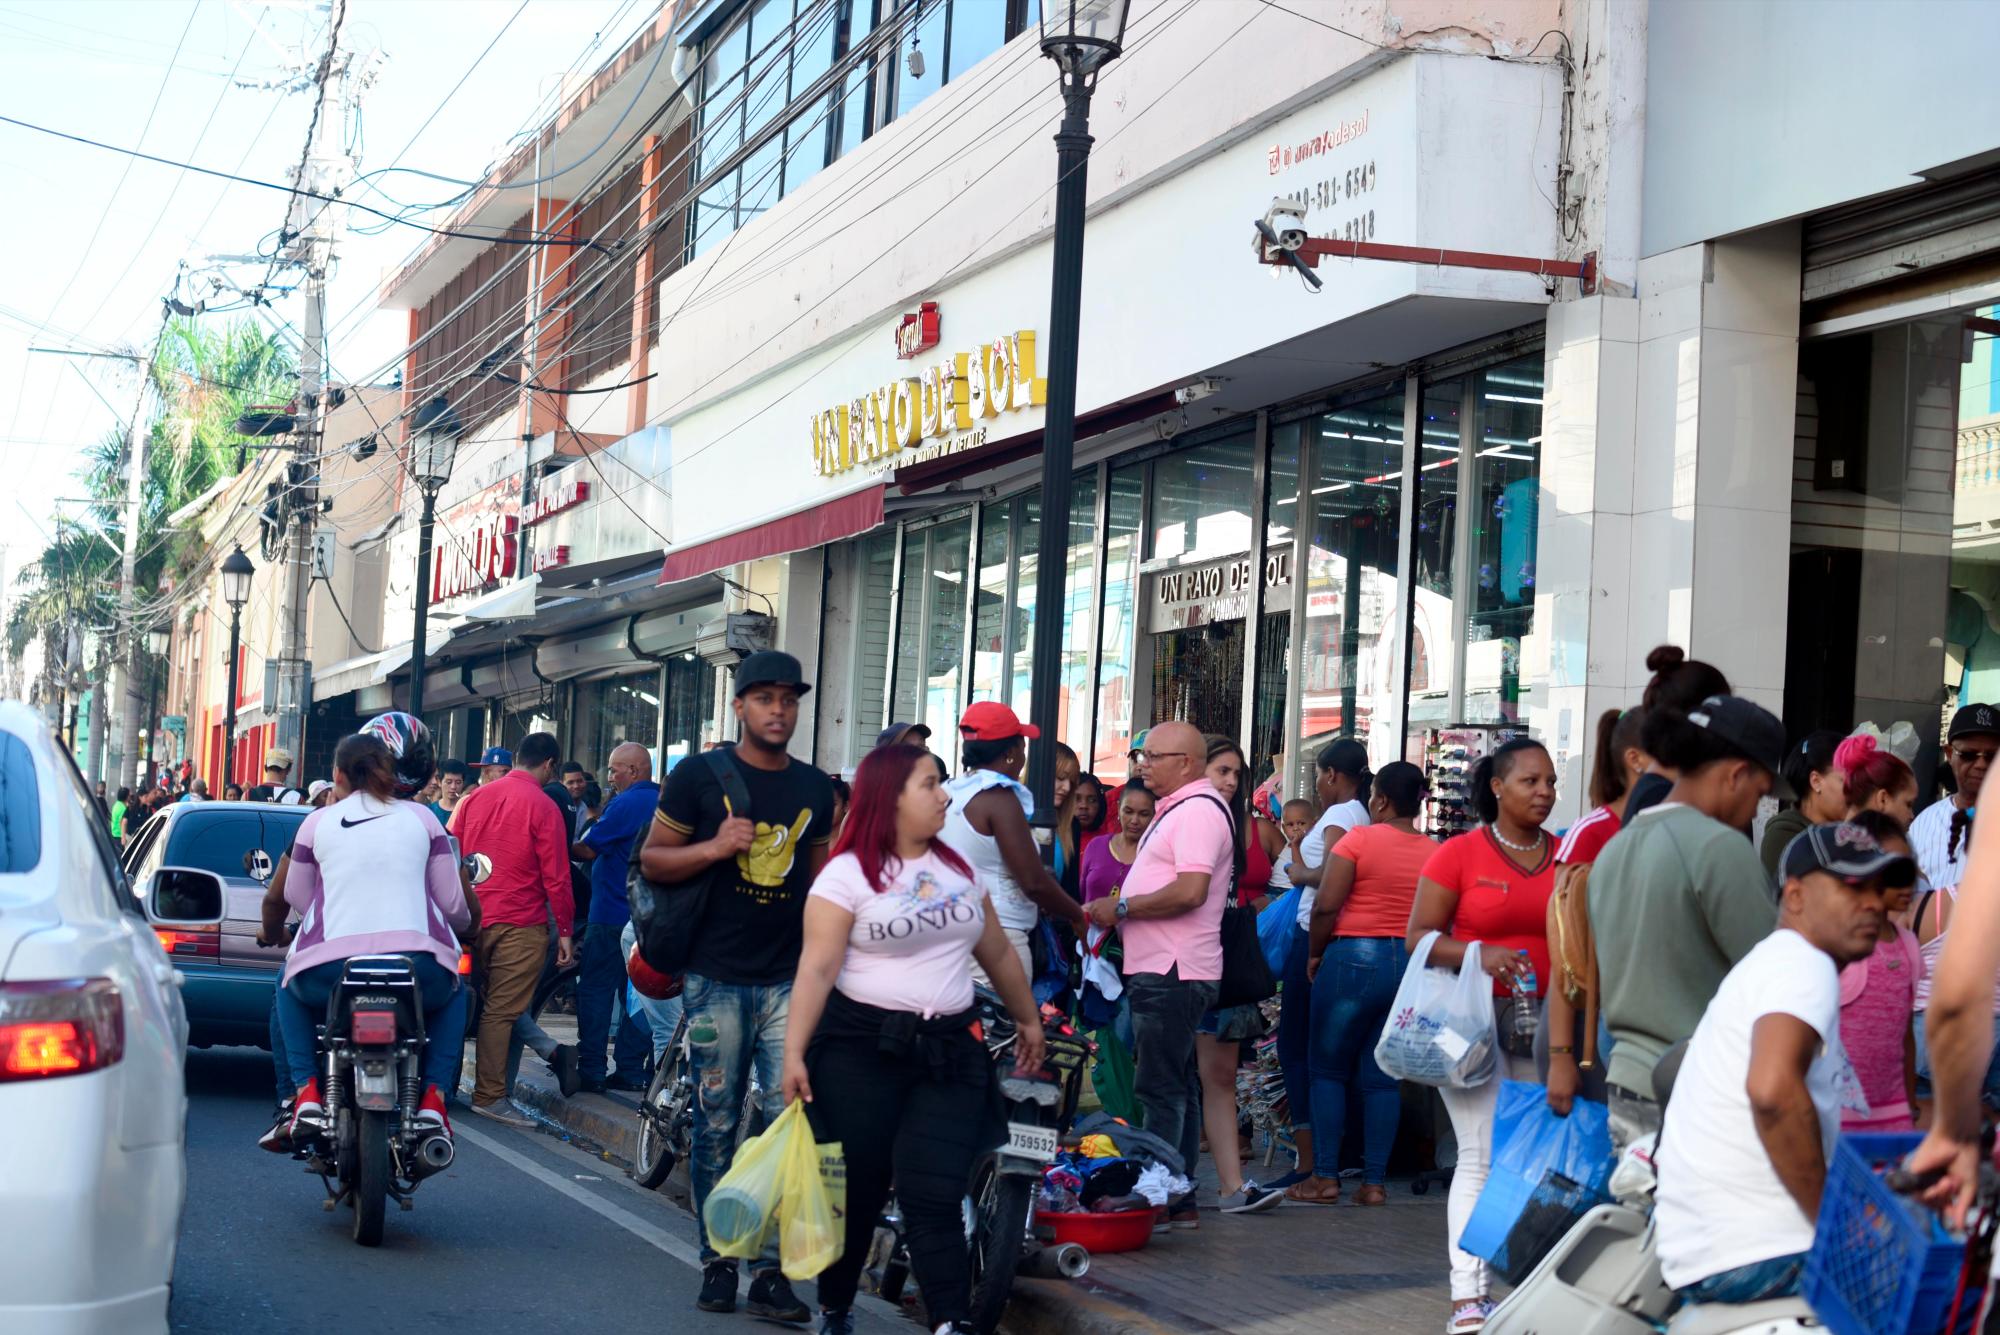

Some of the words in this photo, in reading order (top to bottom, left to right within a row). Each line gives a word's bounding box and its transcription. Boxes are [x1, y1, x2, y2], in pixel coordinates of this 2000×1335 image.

[810, 405, 847, 477] UN
[849, 376, 917, 467] RAYO
[920, 352, 966, 438] DE
[967, 330, 1043, 420] SOL
[1159, 573, 1181, 603] UN
[1187, 567, 1223, 600] RAYO
[1229, 560, 1250, 593] DE
[1265, 553, 1290, 588] OL
[355, 995, 398, 1005] TAURO
[1012, 1133, 1055, 1153] 759532
